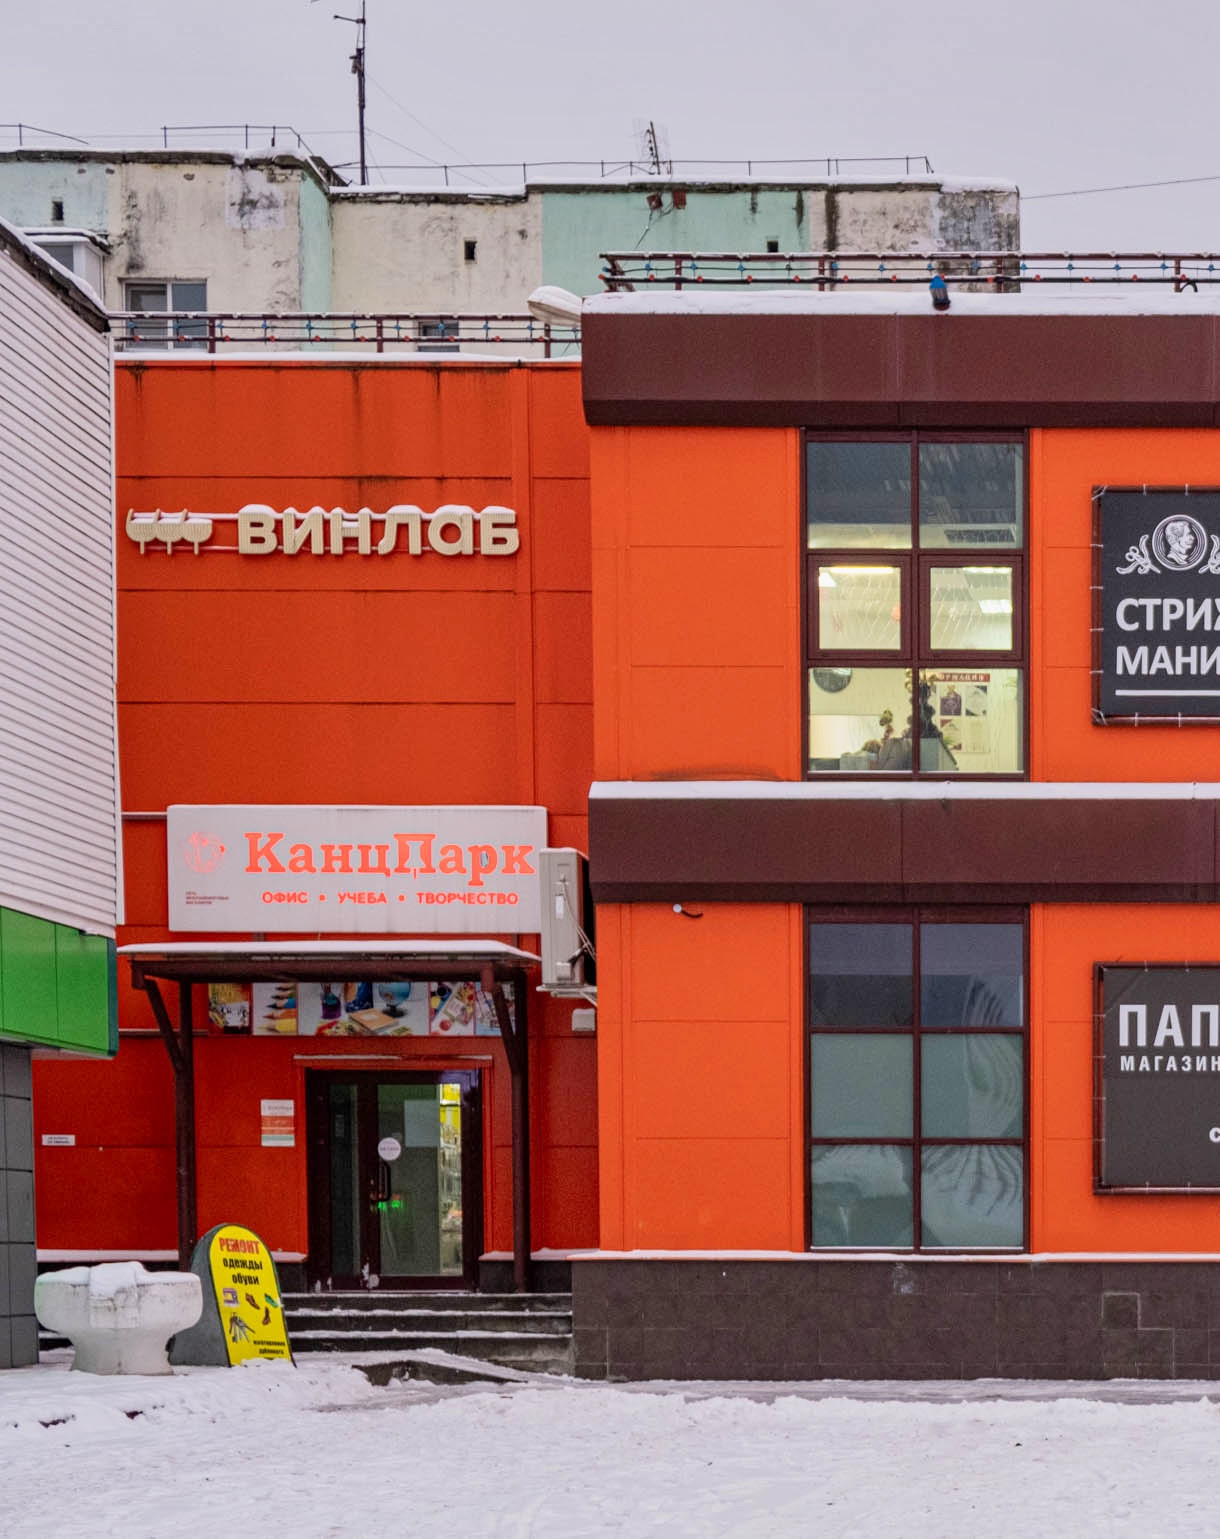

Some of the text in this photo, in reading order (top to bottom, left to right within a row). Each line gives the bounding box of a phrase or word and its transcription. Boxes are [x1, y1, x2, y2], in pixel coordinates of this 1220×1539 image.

[244, 832, 535, 887] КанцПарк
[261, 891, 519, 905] ОФИС УЧЕБА ТВОРЧЕСТВО
[218, 1237, 260, 1255] РЕМОНТ
[223, 1257, 263, 1271] одежды
[232, 1272, 260, 1286] обуви
